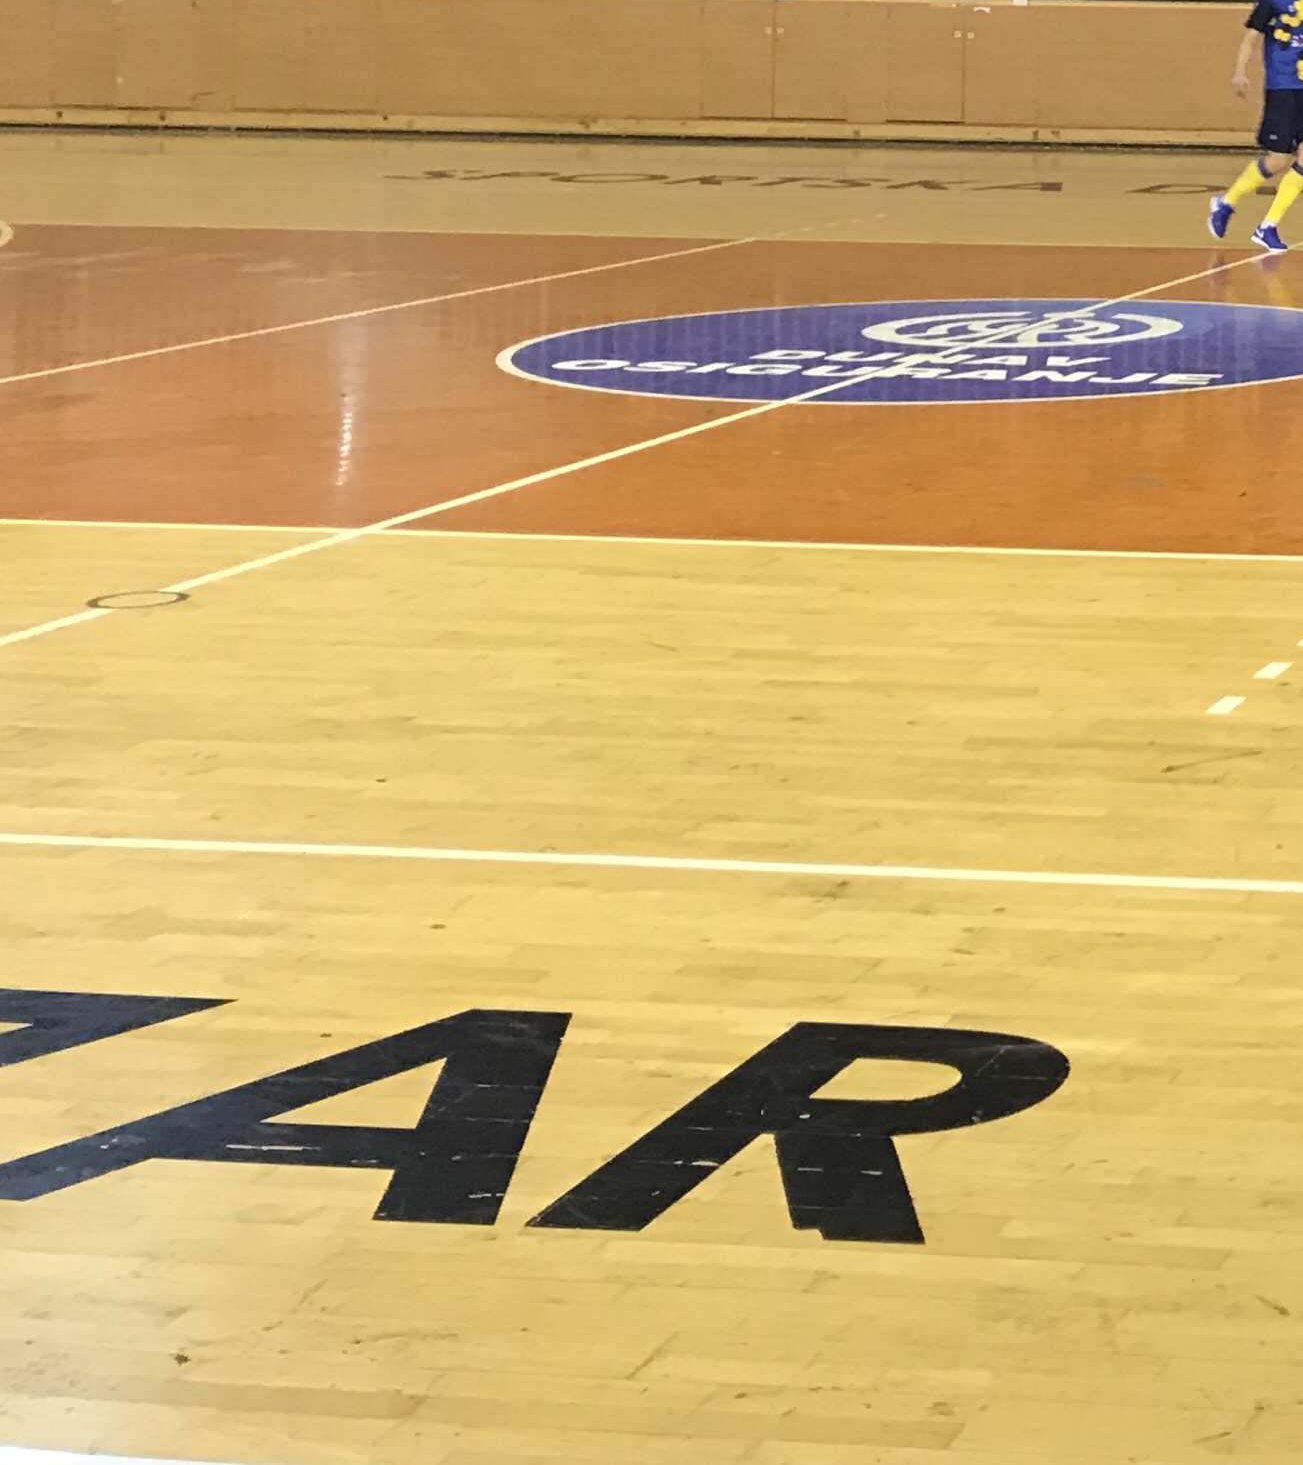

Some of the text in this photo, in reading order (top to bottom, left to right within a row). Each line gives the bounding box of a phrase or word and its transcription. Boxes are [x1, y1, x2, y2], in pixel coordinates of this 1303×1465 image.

[384, 169, 1065, 193] SPORTSKA
[749, 349, 1112, 367] DUNAV
[551, 359, 1224, 385] OSIGURANJE
